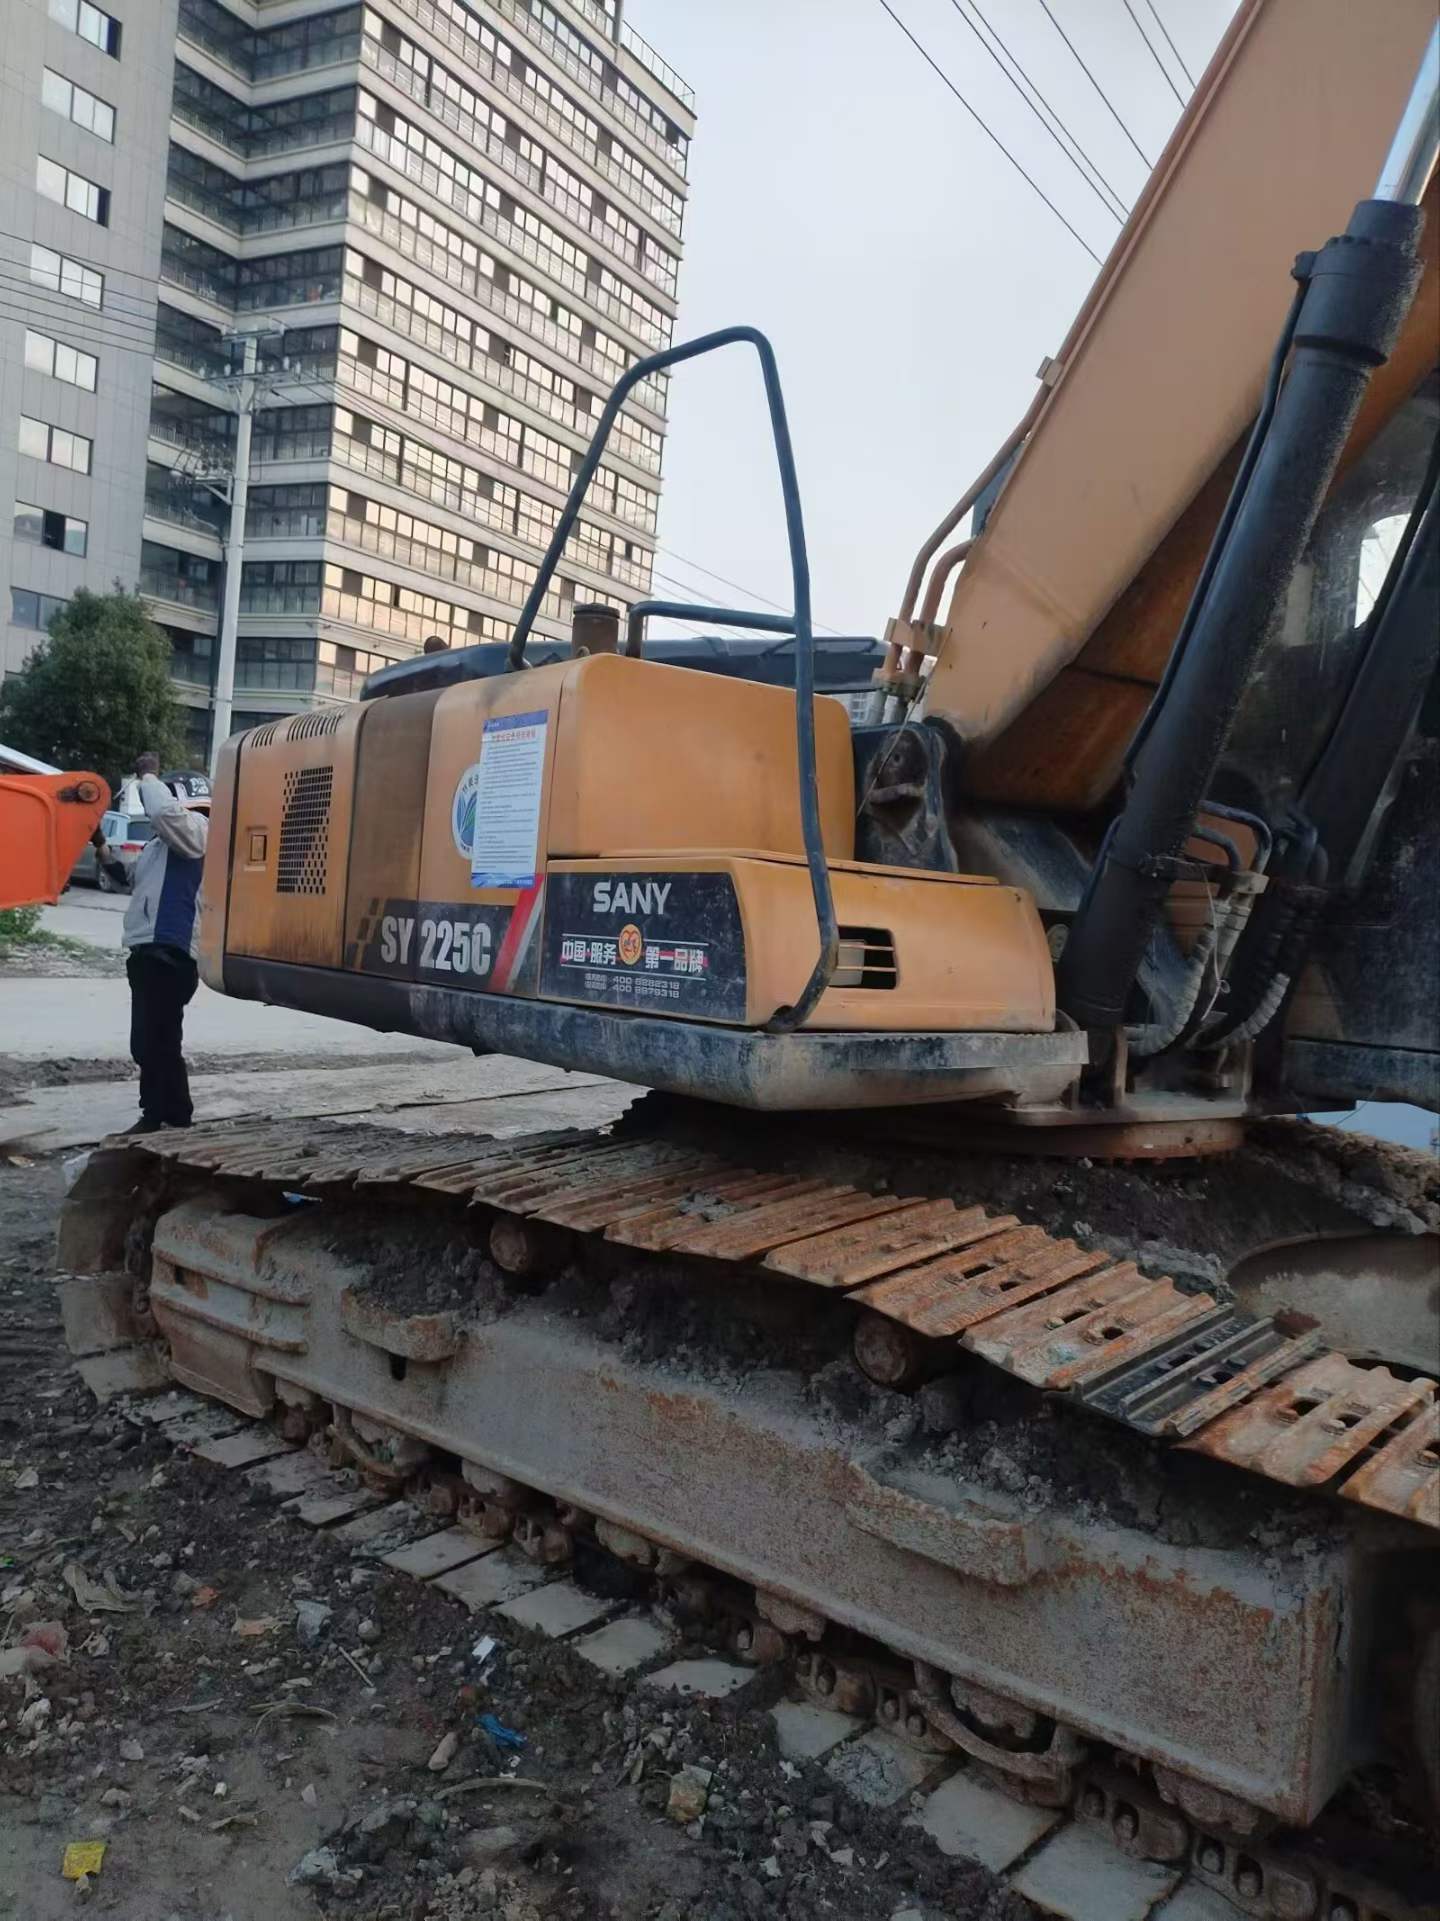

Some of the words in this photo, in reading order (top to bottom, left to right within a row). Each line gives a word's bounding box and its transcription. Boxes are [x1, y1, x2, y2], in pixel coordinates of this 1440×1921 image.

[593, 880, 672, 915] SANY
[381, 915, 415, 965] SY
[420, 919, 492, 976] 225C
[645, 945, 704, 972] 第一品牌
[612, 975, 633, 985] 400
[612, 984, 632, 993] 400
